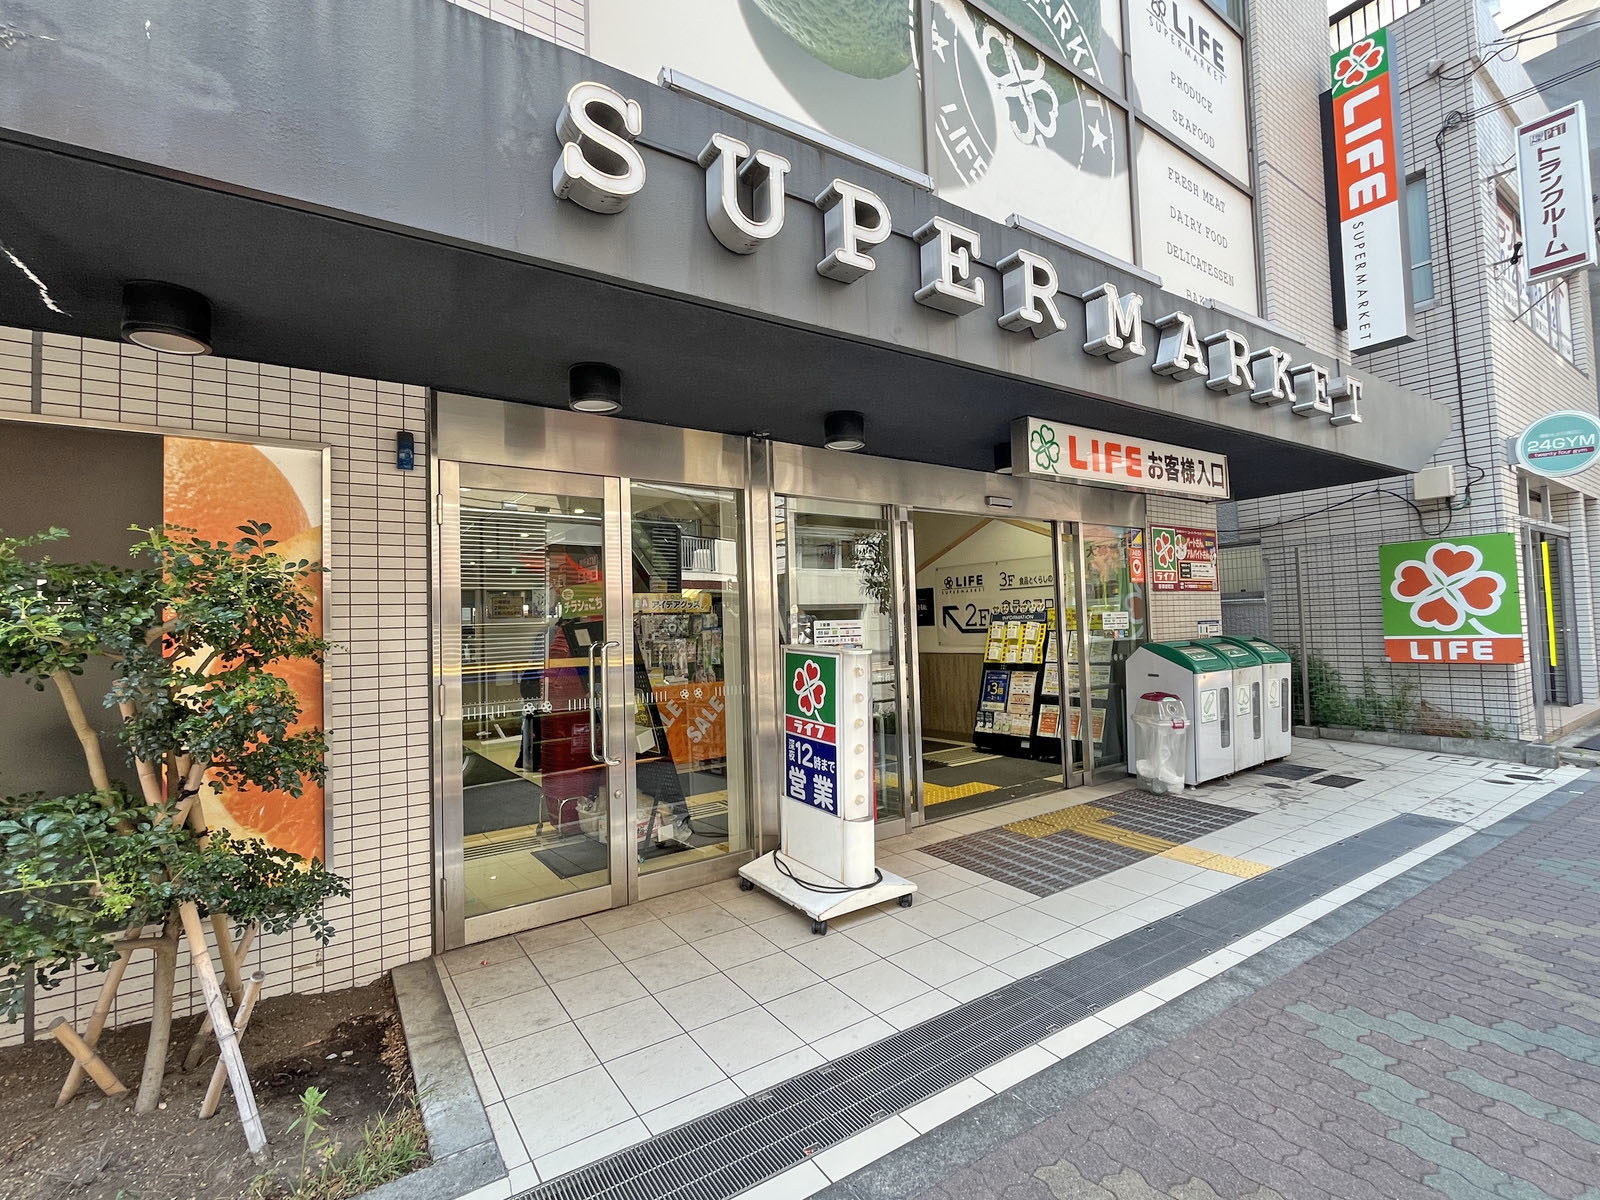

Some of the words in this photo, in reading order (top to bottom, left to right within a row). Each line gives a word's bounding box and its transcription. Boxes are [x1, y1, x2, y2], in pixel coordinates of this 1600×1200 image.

[1149, 15, 1224, 84] SUPERMARKET
[1172, 1, 1225, 73] LIFE
[1170, 71, 1213, 114] PRODUCE
[1172, 109, 1215, 149] SEAFOOD
[1343, 84, 1387, 211] LIFE
[1167, 166, 1200, 197] FRESH
[1202, 188, 1226, 213] MEAT
[1537, 146, 1569, 257] トランクルーム
[1169, 205, 1202, 235] DAIRY
[1204, 226, 1228, 249] FOOD
[553, 80, 1364, 427] SUPERMARKET
[1166, 241, 1235, 287] DELICATESSEN
[1352, 221, 1371, 340] SUPERMARKET
[1068, 435, 1143, 478] LIFE
[1147, 451, 1225, 489] お客様入口
[1527, 433, 1595, 452] 24GYM
[955, 574, 983, 587] LIFE
[1000, 571, 1016, 587] 3F
[1156, 571, 1175, 581] ライフ
[965, 603, 990, 627] 2F
[1410, 640, 1494, 660] LIFE
[686, 695, 725, 744] SALE
[793, 719, 825, 739] ライフ
[788, 764, 834, 812] 営業
